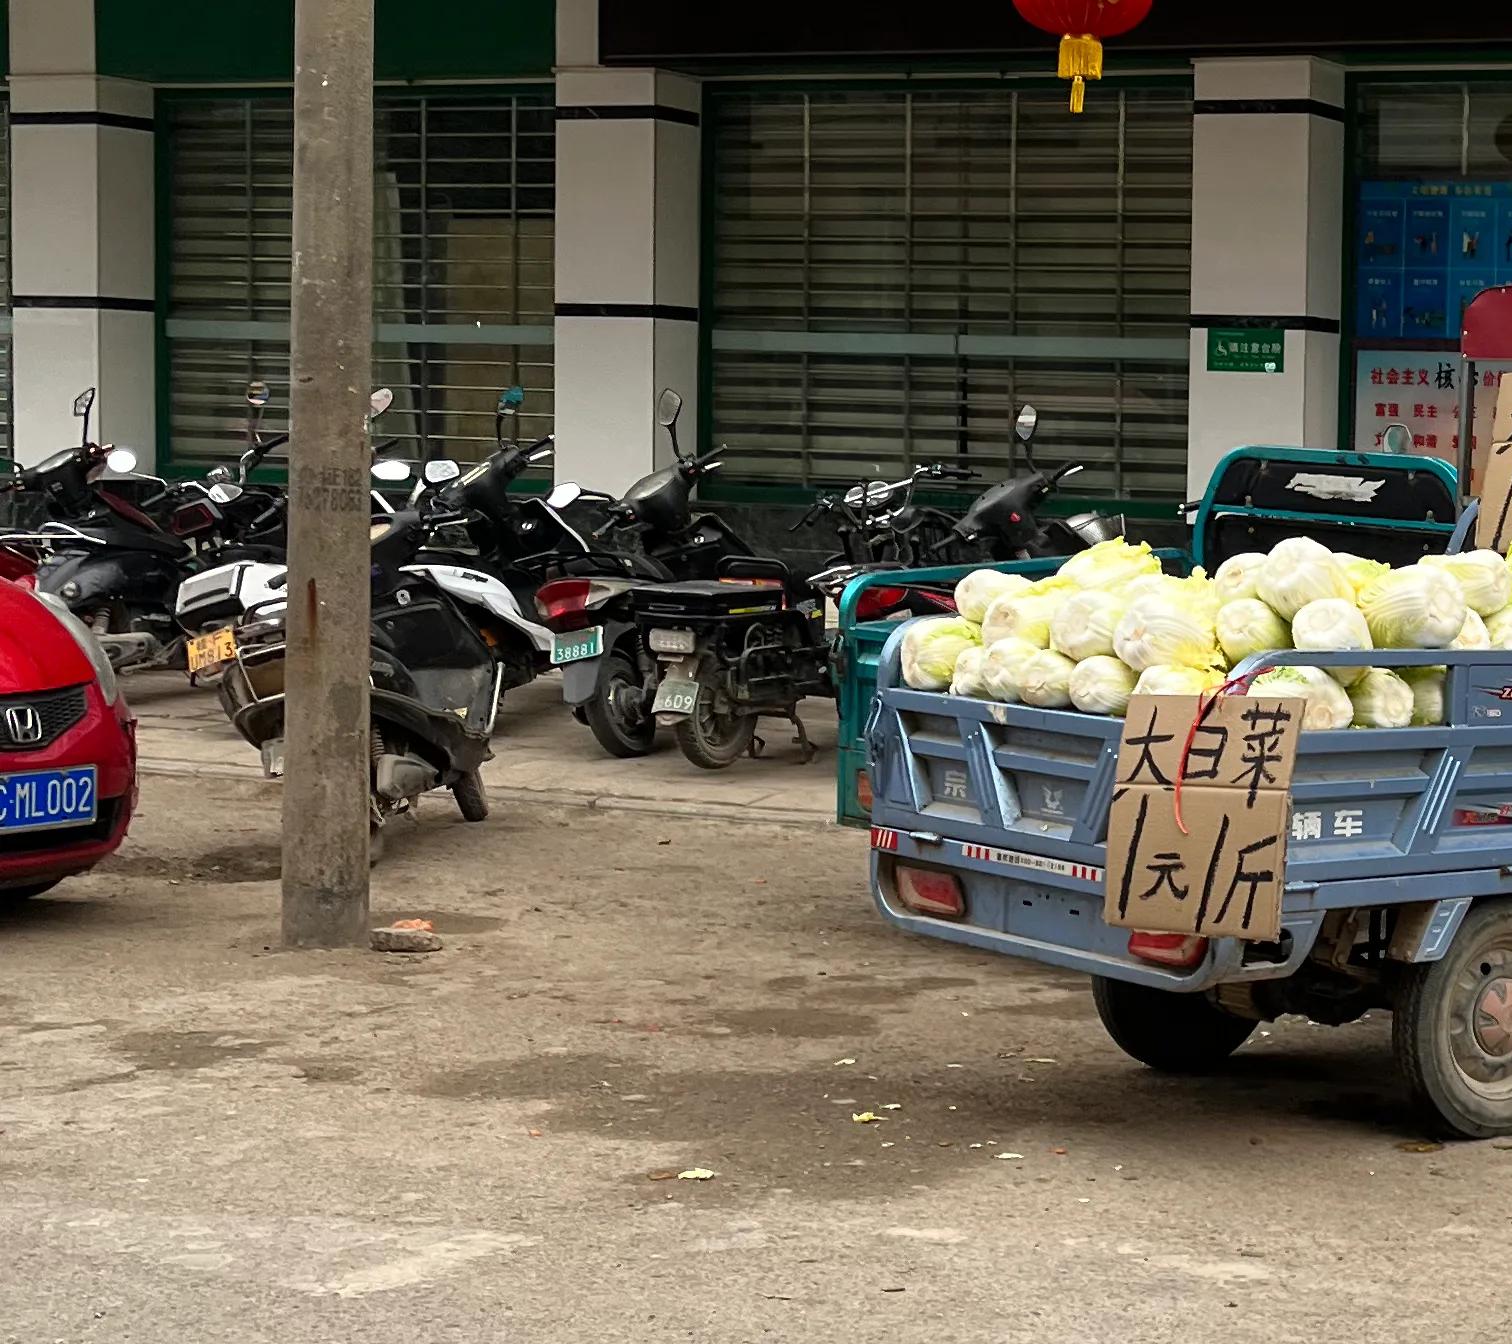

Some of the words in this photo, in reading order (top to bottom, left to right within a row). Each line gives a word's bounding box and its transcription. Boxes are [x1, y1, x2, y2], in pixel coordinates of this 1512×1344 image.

[1413, 403, 1438, 417] 民主
[557, 642, 594, 660] 38881
[1112, 701, 1291, 808] 大白菜
